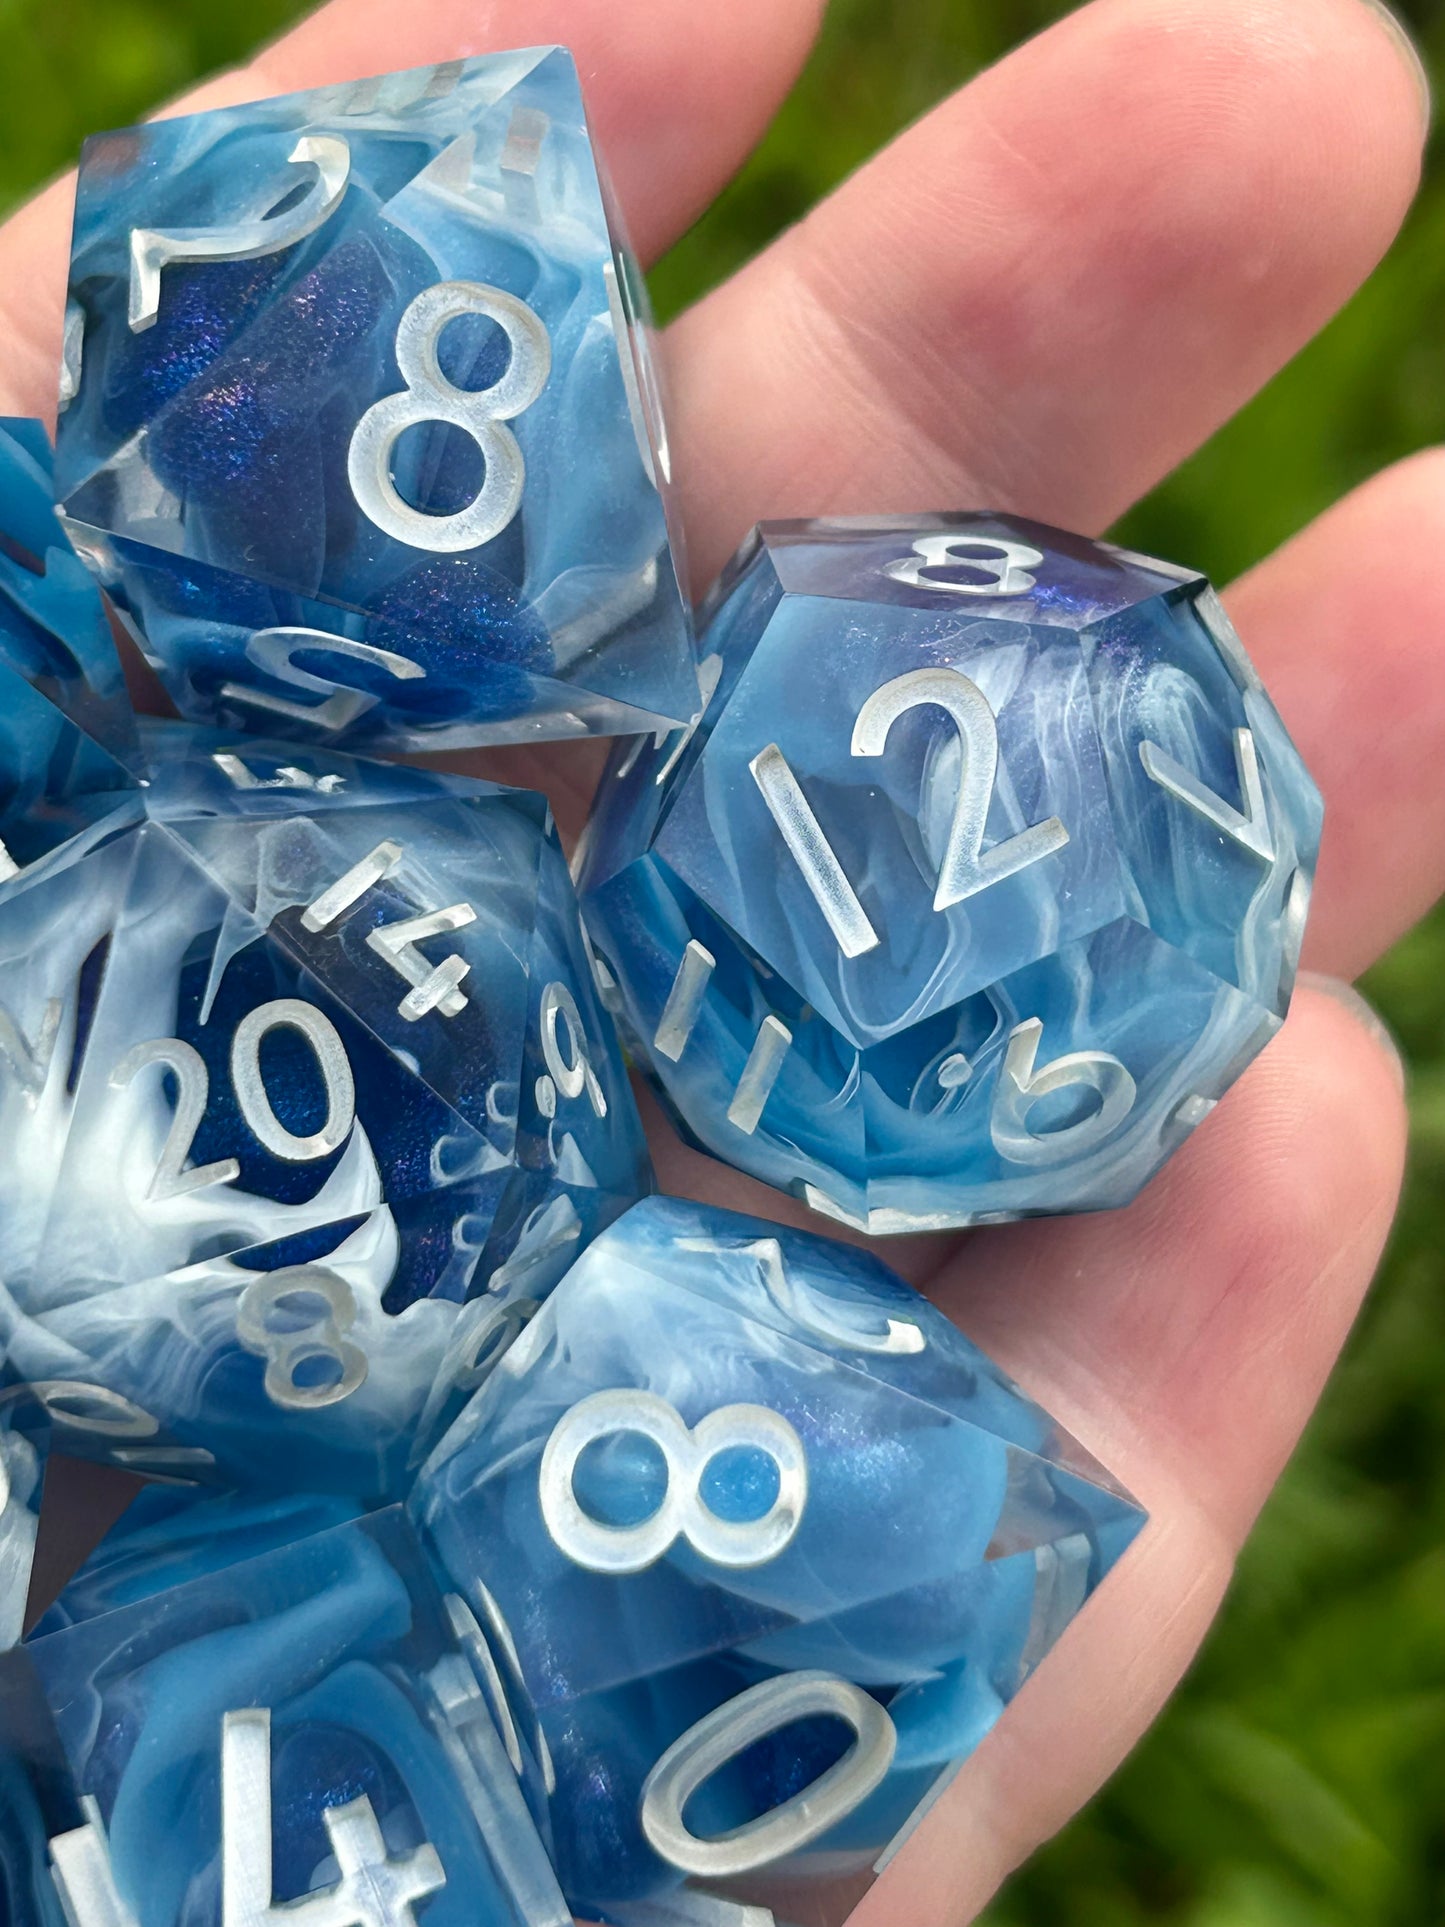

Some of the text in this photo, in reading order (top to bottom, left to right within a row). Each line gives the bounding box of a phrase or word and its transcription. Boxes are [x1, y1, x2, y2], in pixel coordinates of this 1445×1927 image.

[347, 281, 552, 552] 8
[884, 535, 1044, 596] 8
[749, 666, 1070, 958] 12
[108, 998, 355, 1201] 20
[236, 1264, 368, 1408] 8
[540, 1387, 807, 1574] 8
[642, 1670, 898, 1876] 0
